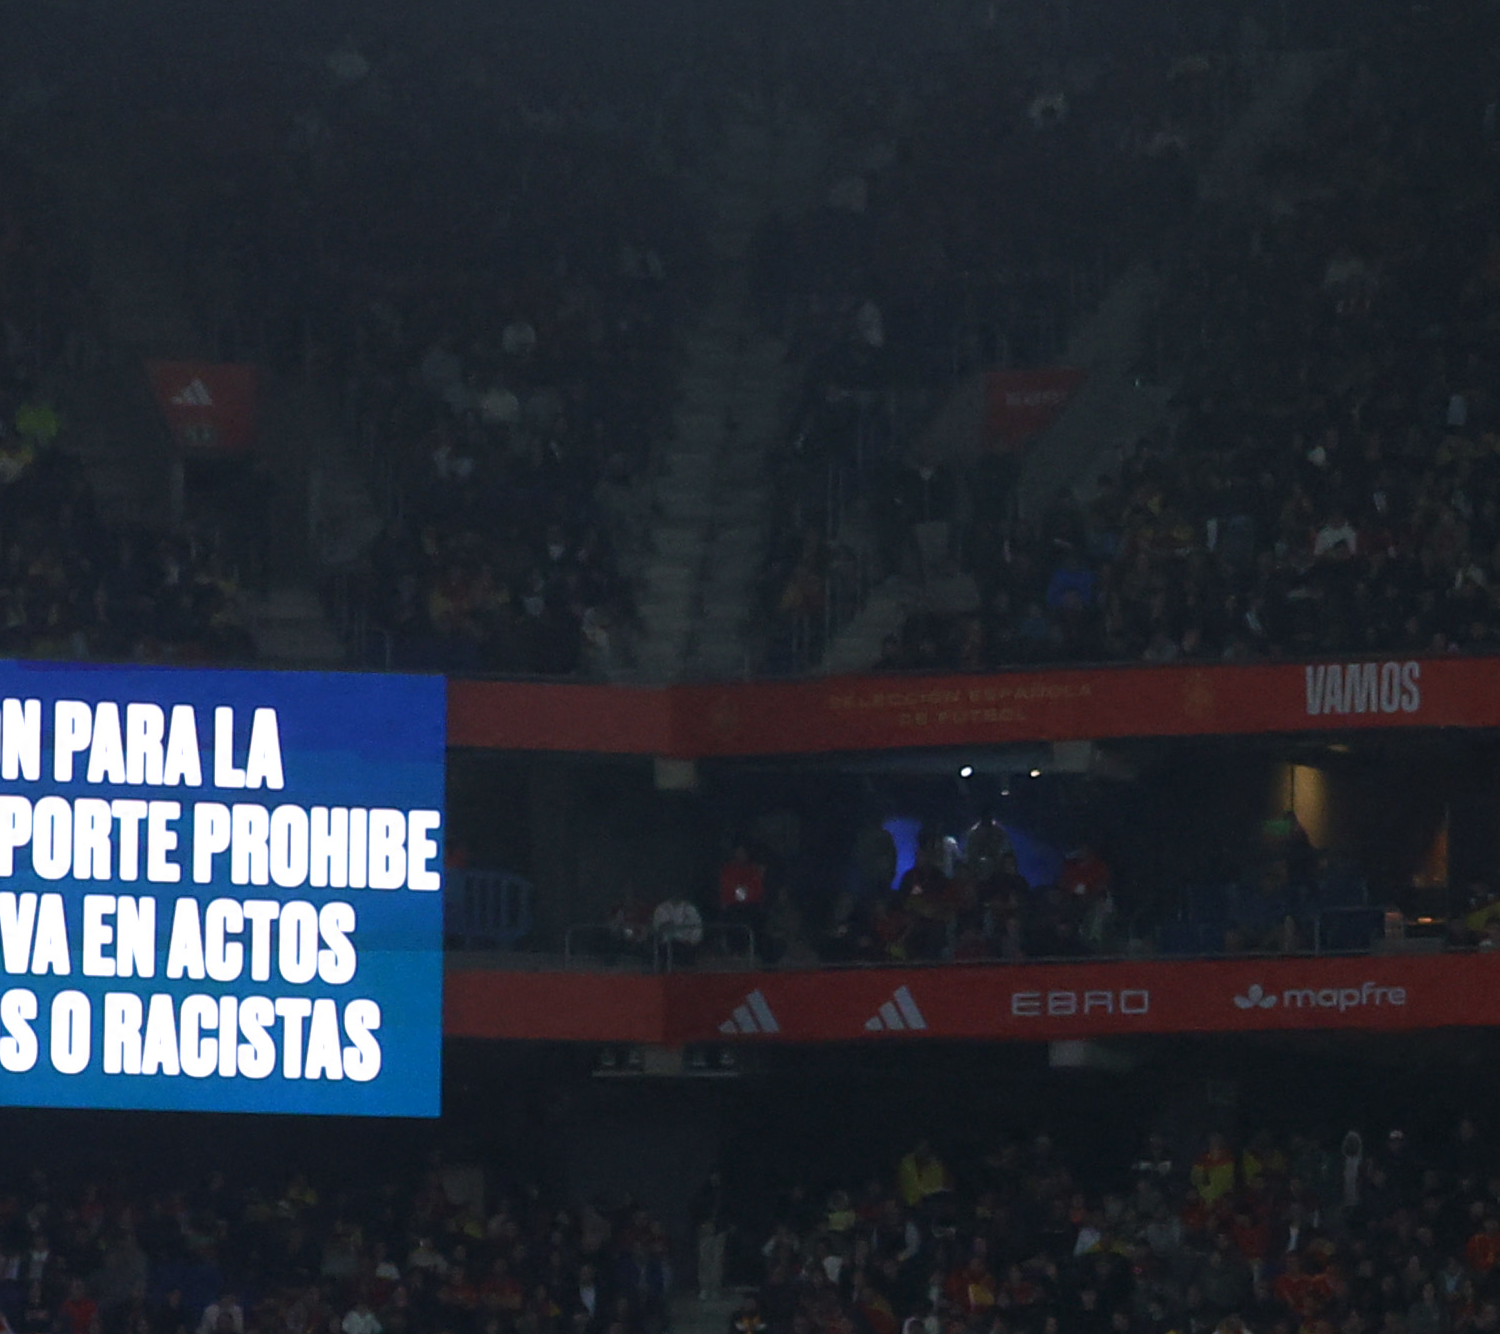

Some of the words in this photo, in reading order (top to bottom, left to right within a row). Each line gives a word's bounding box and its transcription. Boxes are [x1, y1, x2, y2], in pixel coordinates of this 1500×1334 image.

[1305, 661, 1421, 715] VAMOS
[55, 701, 202, 786] PARA
[215, 707, 284, 789] LA
[194, 802, 441, 891] PROHIBE
[83, 895, 155, 977] EN
[167, 898, 356, 984] ACTOS
[51, 990, 90, 1073] O
[104, 993, 381, 1081] RACISTAS
[1283, 980, 1407, 1013] mapfre
